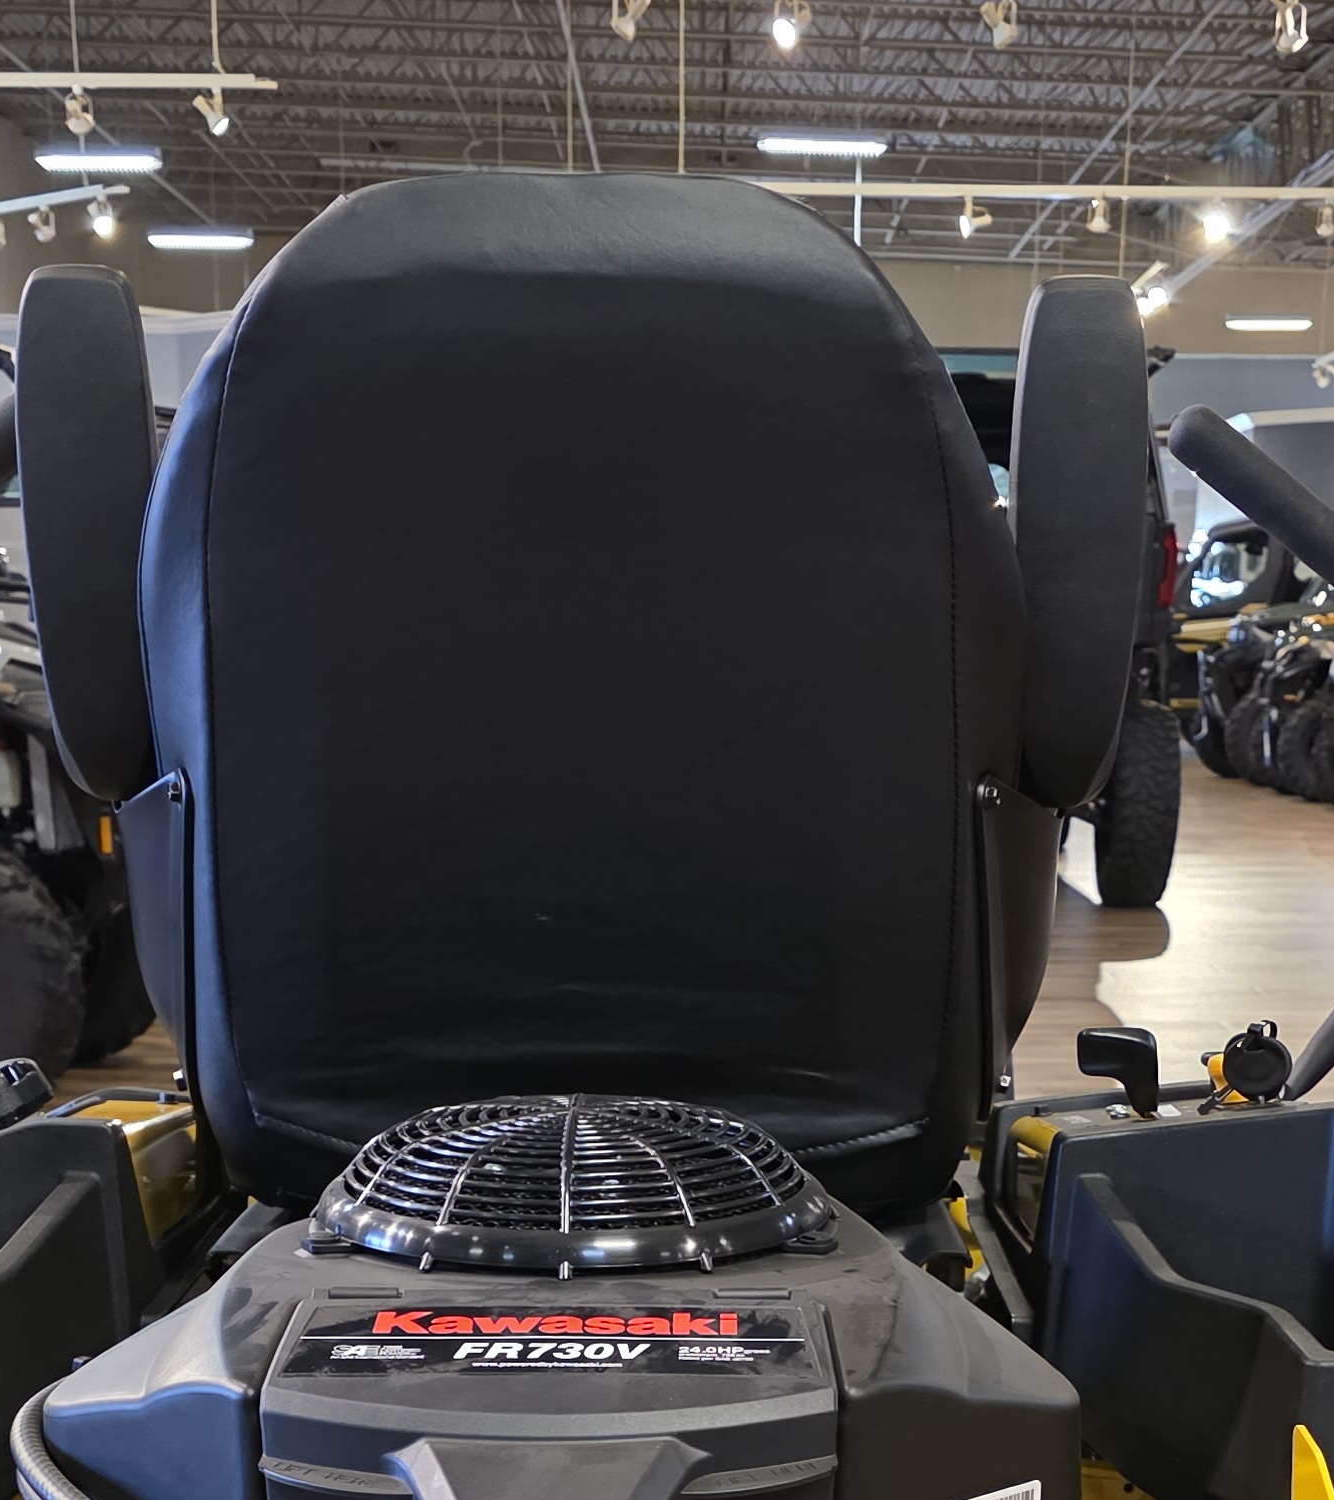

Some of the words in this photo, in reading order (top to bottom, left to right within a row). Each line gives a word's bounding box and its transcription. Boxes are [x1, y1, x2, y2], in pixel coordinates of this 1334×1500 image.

[372, 1311, 738, 1335] Kawasaki
[453, 1342, 651, 1360] FR730V
[273, 1461, 316, 1476] LIFT
[324, 1472, 376, 1488] HERE
